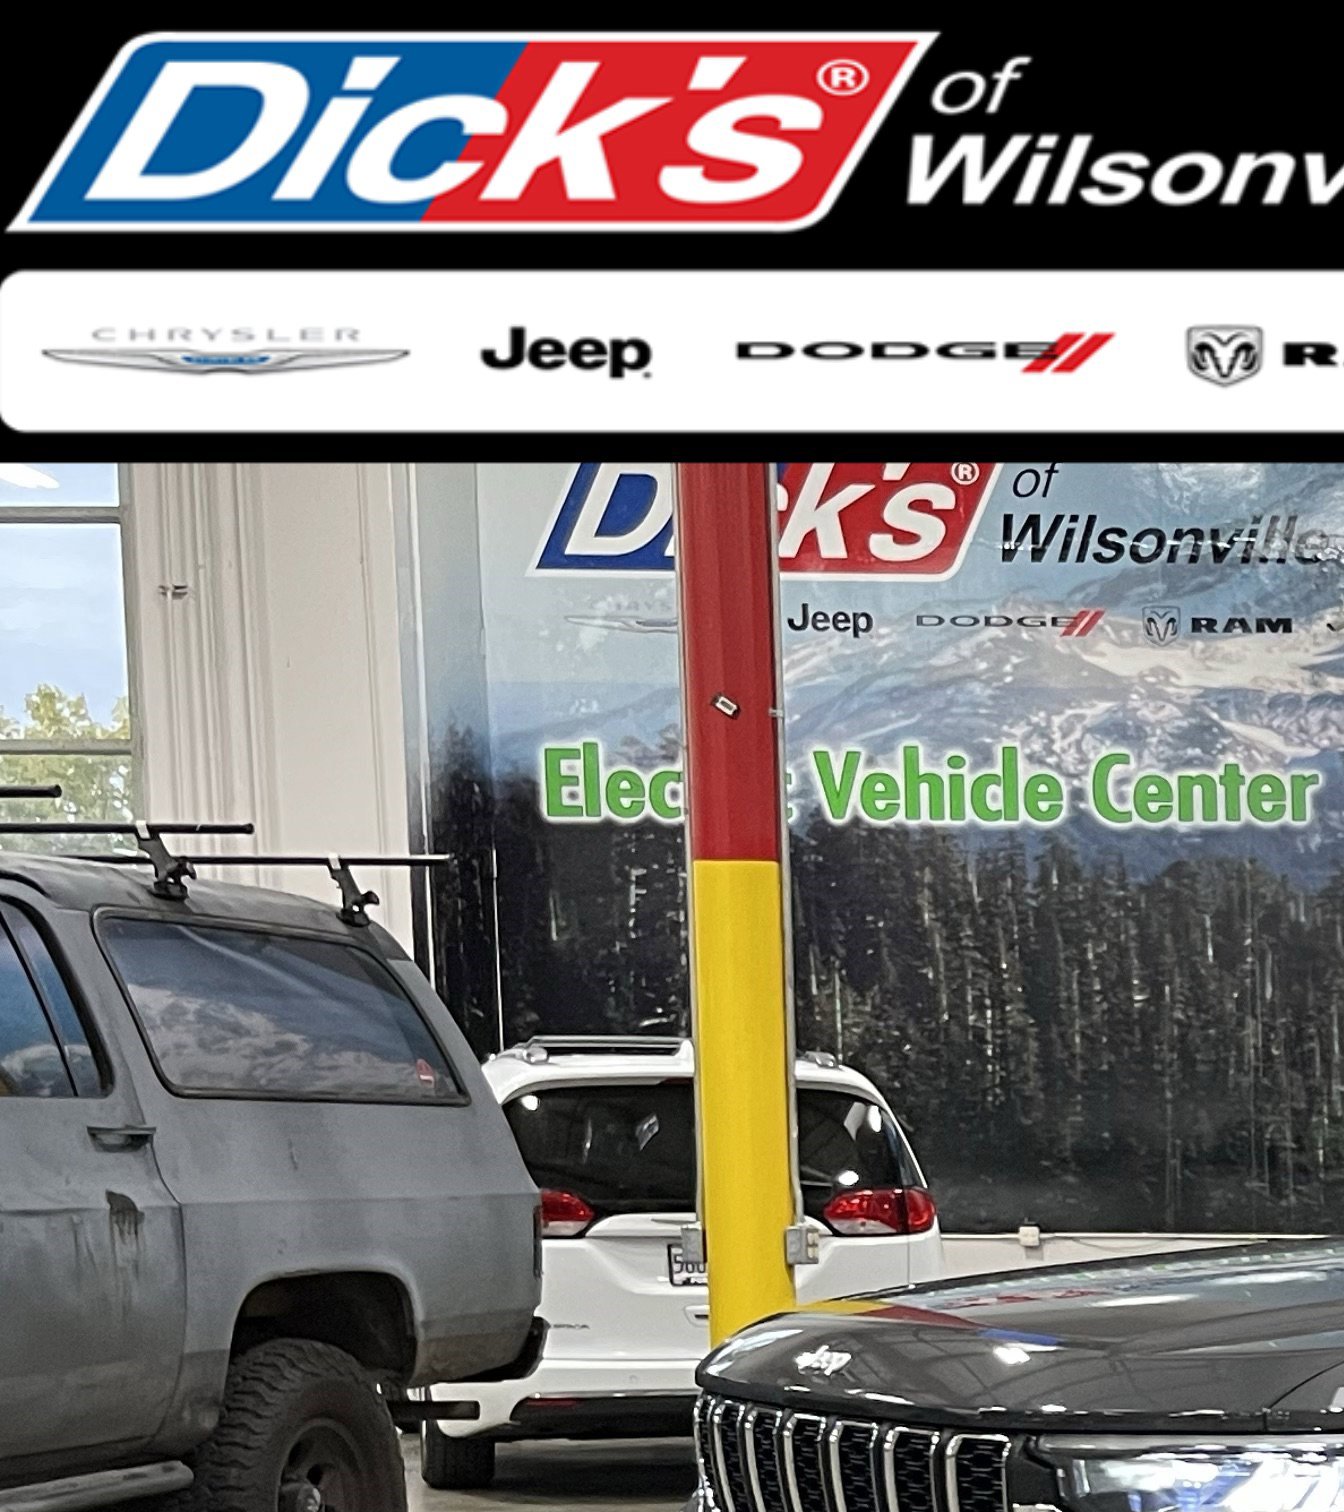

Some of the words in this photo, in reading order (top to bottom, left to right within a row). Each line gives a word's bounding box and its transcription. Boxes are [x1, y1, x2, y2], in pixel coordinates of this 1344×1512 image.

[1012, 462, 1060, 499] of
[786, 602, 874, 639] Jeep
[916, 614, 1078, 628] DODGE
[1190, 616, 1294, 635] RAM
[813, 745, 1064, 822] Vehicle
[1092, 752, 1319, 823] Center
